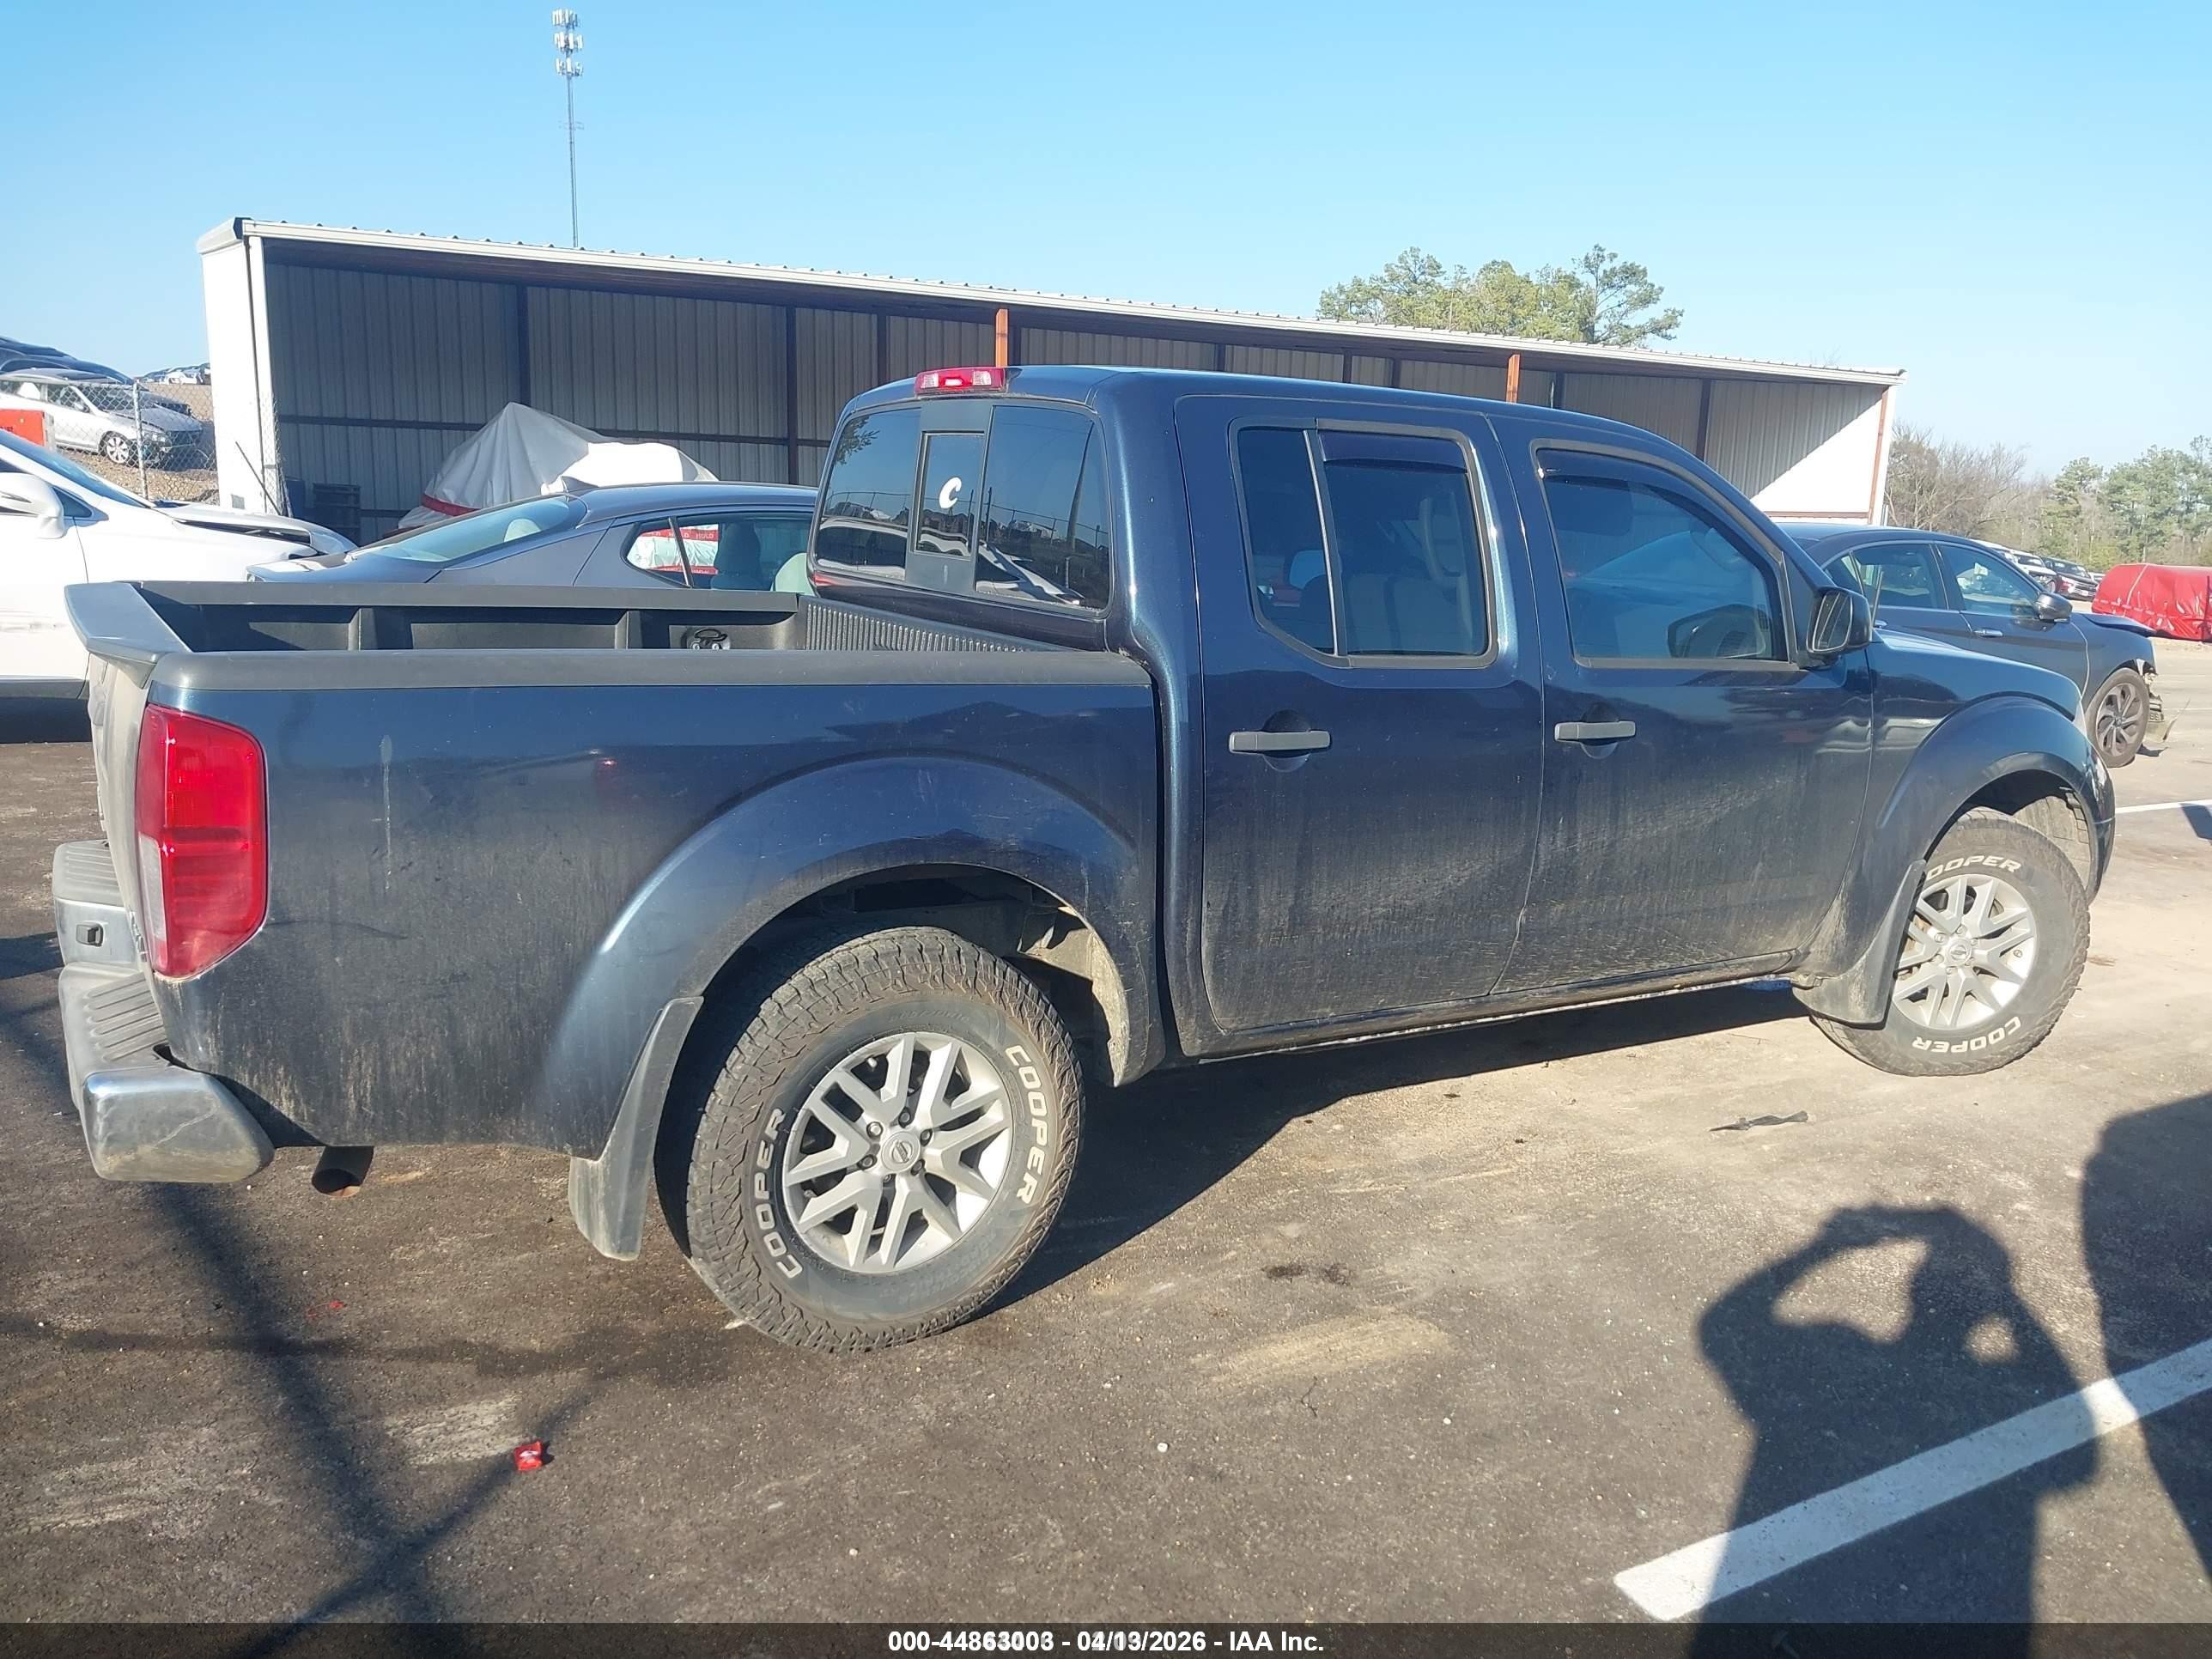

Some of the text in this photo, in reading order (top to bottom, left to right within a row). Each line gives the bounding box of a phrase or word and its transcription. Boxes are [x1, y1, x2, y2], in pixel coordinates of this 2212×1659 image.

[1925, 854, 2022, 881] OOPER
[1911, 1016, 2022, 1054] COOPER
[1005, 1044, 1048, 1205] COOPER
[753, 1108, 804, 1279] COOPER
